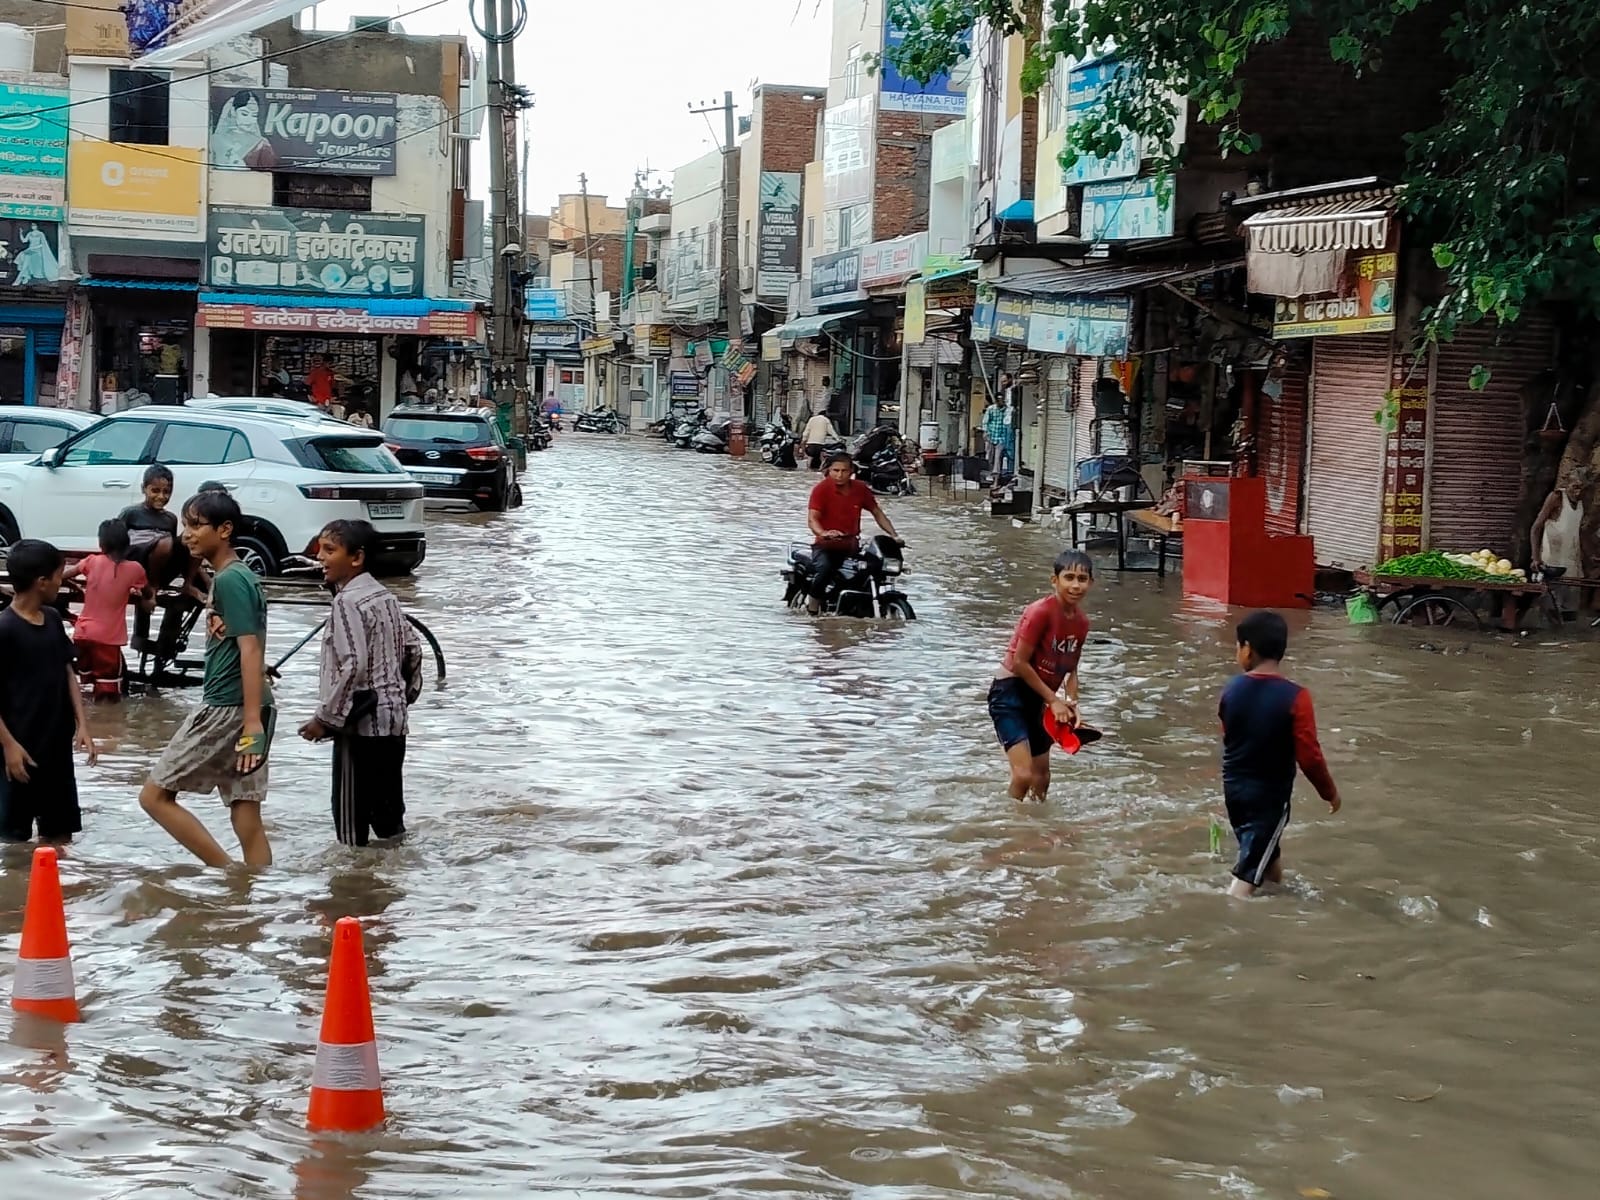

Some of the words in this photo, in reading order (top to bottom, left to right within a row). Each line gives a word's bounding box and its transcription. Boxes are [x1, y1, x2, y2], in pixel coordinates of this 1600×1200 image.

[889, 94, 941, 105] HARYANA
[264, 103, 395, 143] Kapoor
[317, 141, 392, 158] Jewellers
[217, 219, 292, 257] उतरेजा
[762, 225, 798, 236] MOTORS
[251, 309, 312, 327] उतरेजा
